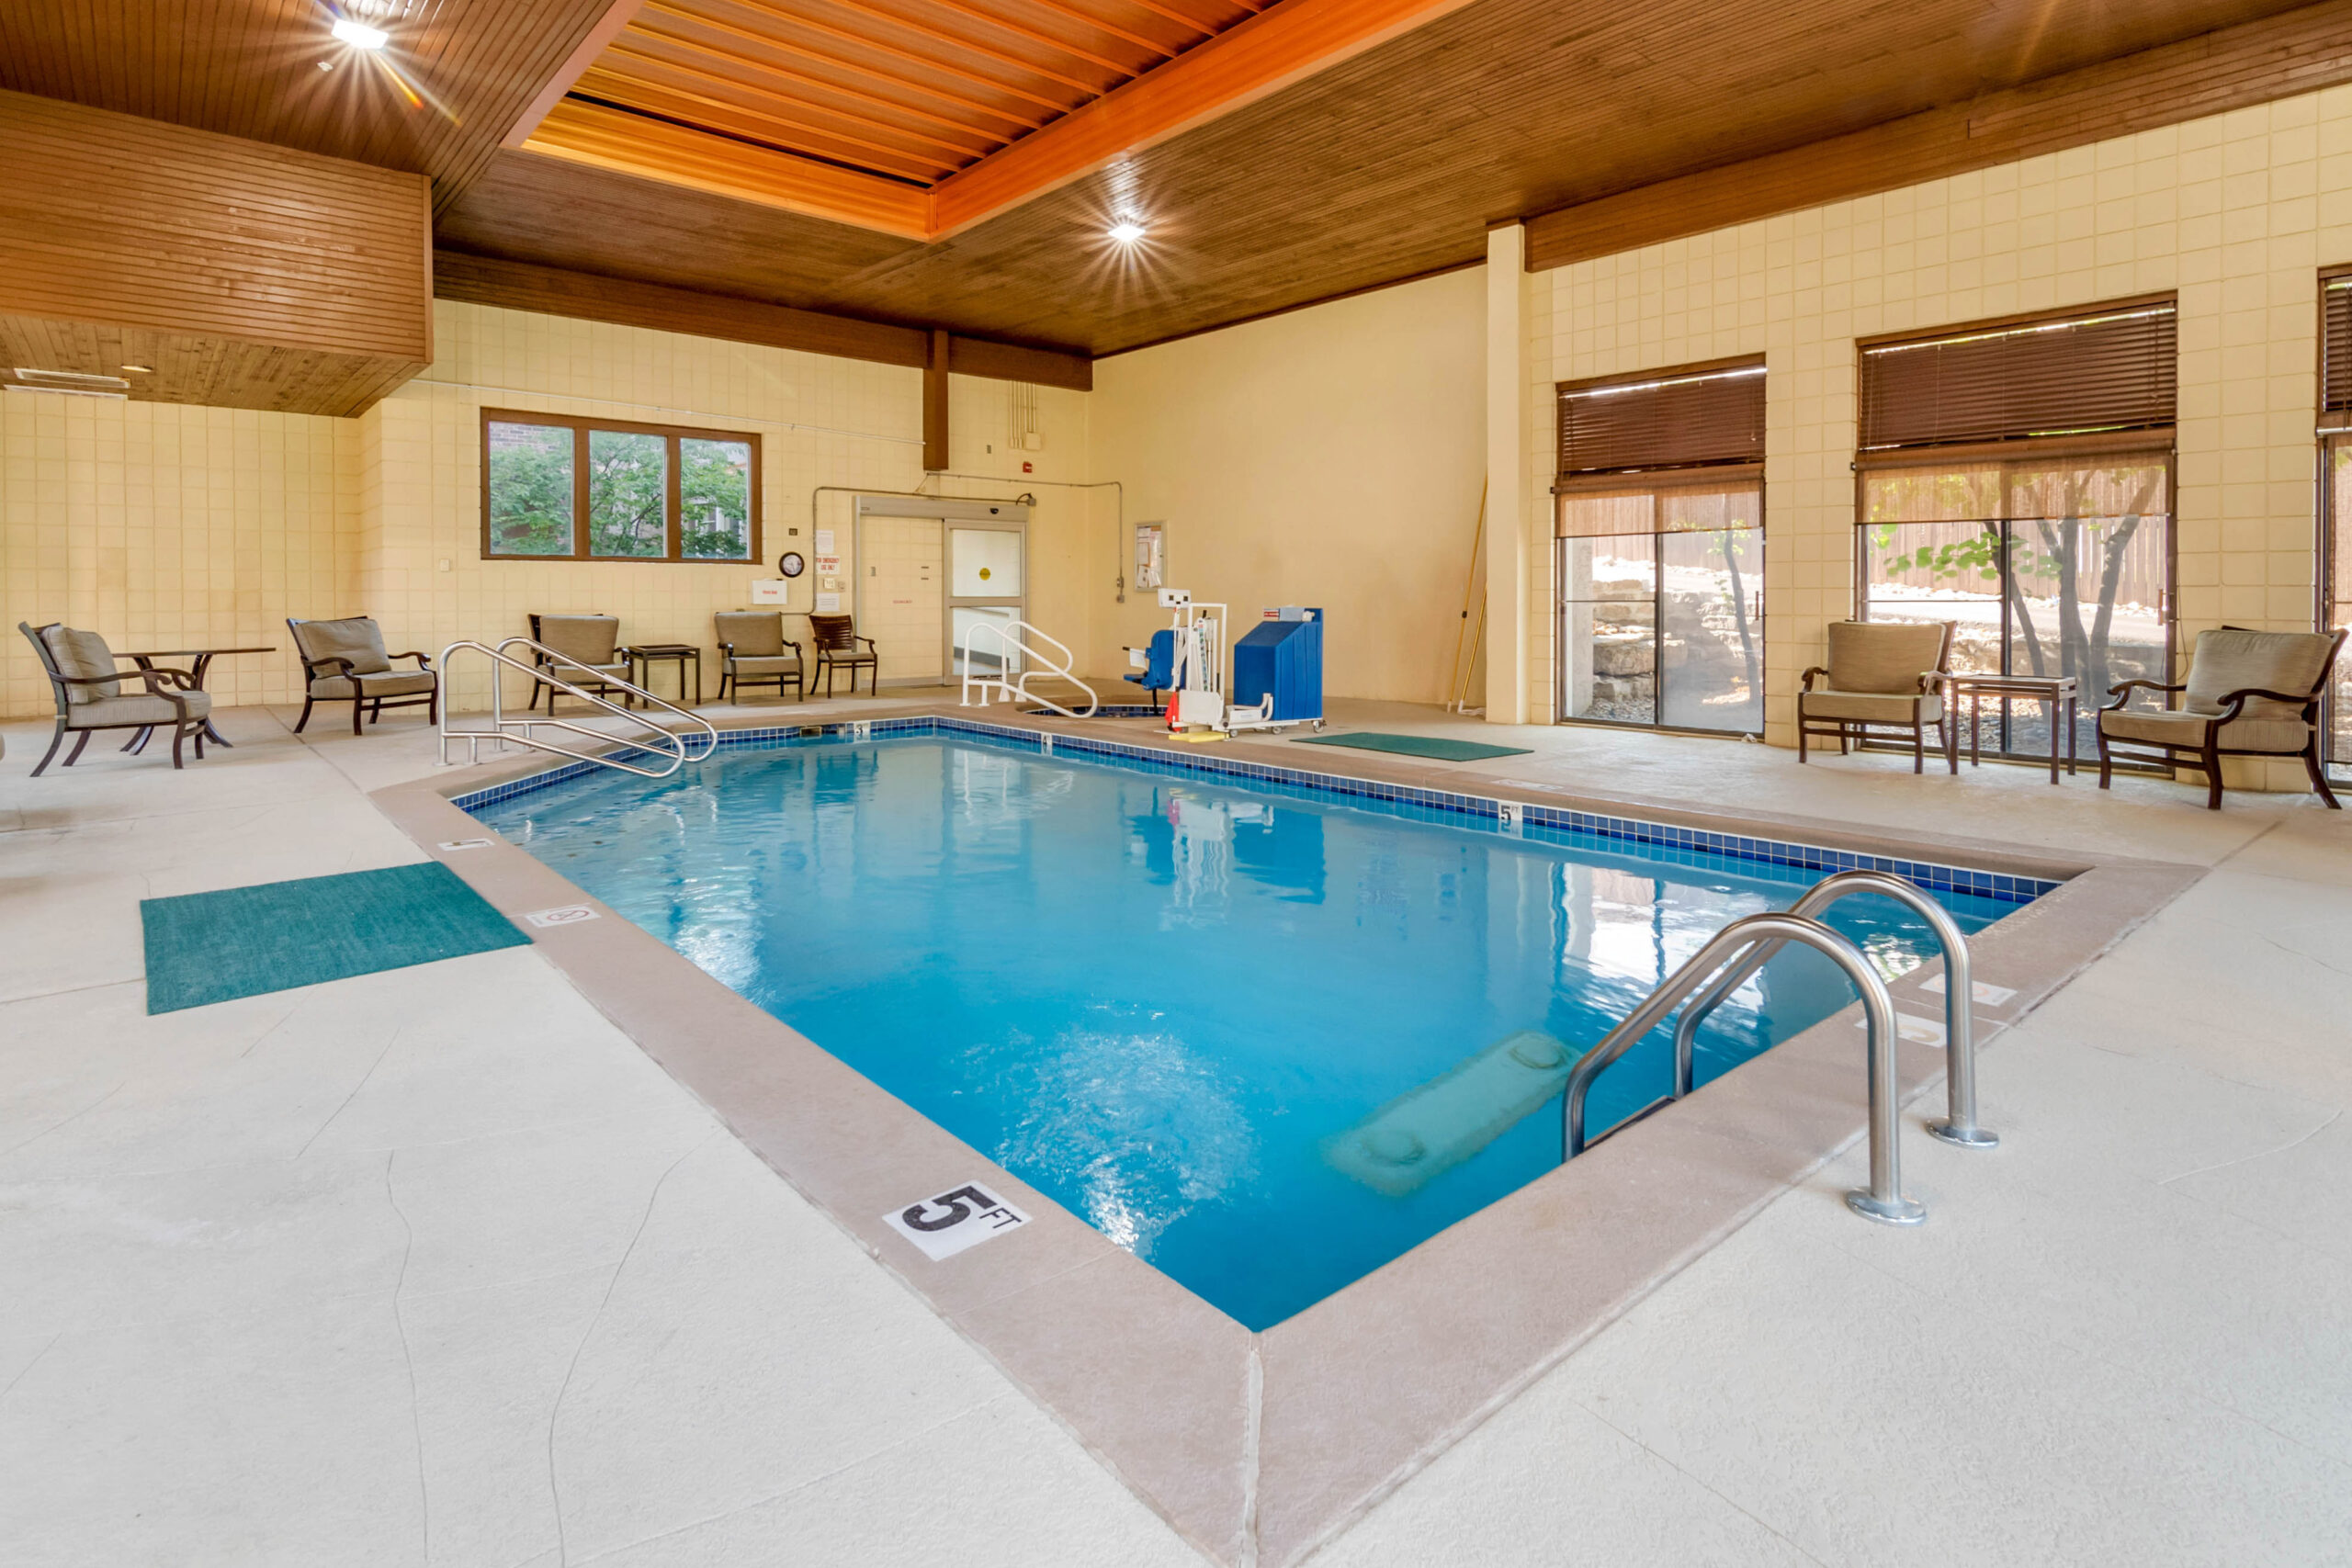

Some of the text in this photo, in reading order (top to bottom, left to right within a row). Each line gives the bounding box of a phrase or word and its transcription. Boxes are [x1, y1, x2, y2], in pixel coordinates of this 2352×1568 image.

[1500, 805, 1511, 823] 5
[902, 1185, 1022, 1232] 5 FT
